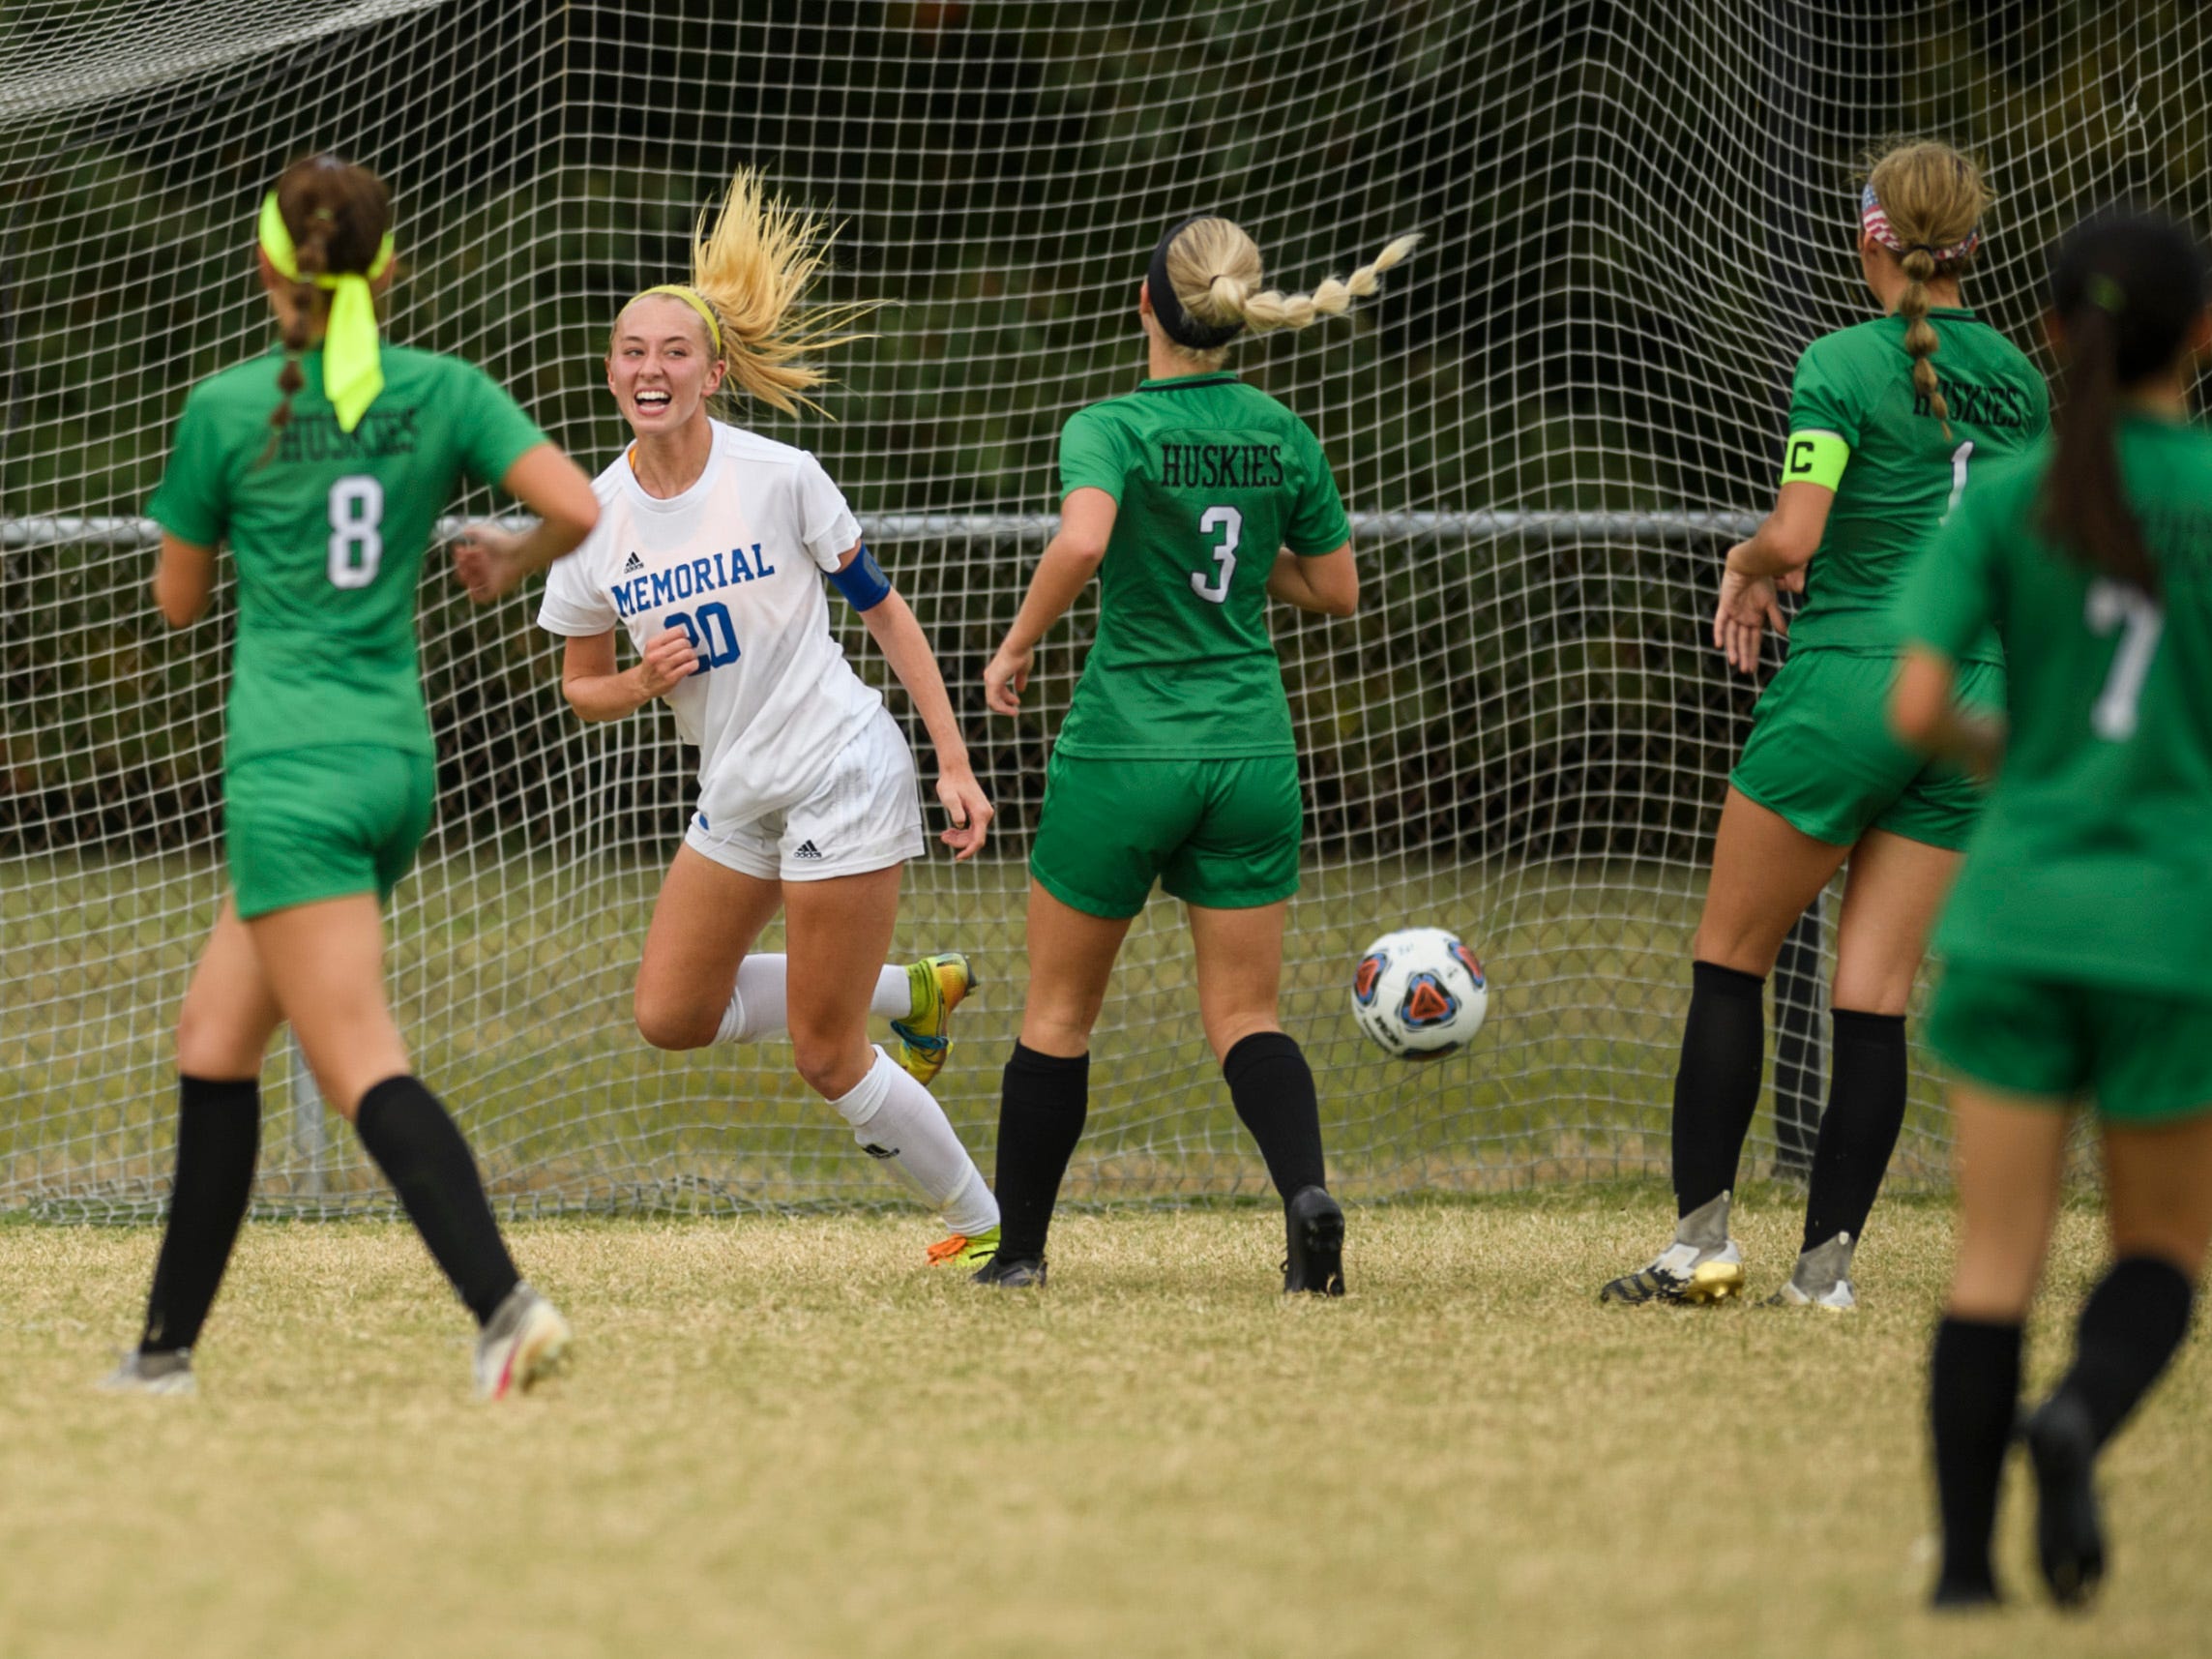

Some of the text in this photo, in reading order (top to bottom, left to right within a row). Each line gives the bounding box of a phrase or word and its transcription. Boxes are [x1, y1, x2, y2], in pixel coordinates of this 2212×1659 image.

[1162, 444, 1284, 488] HUSKIES
[1790, 441, 1814, 473] C
[327, 474, 384, 590] 8
[1191, 505, 1243, 604] 3
[610, 543, 776, 618] MEMORIAL
[2084, 578, 2165, 742] 7
